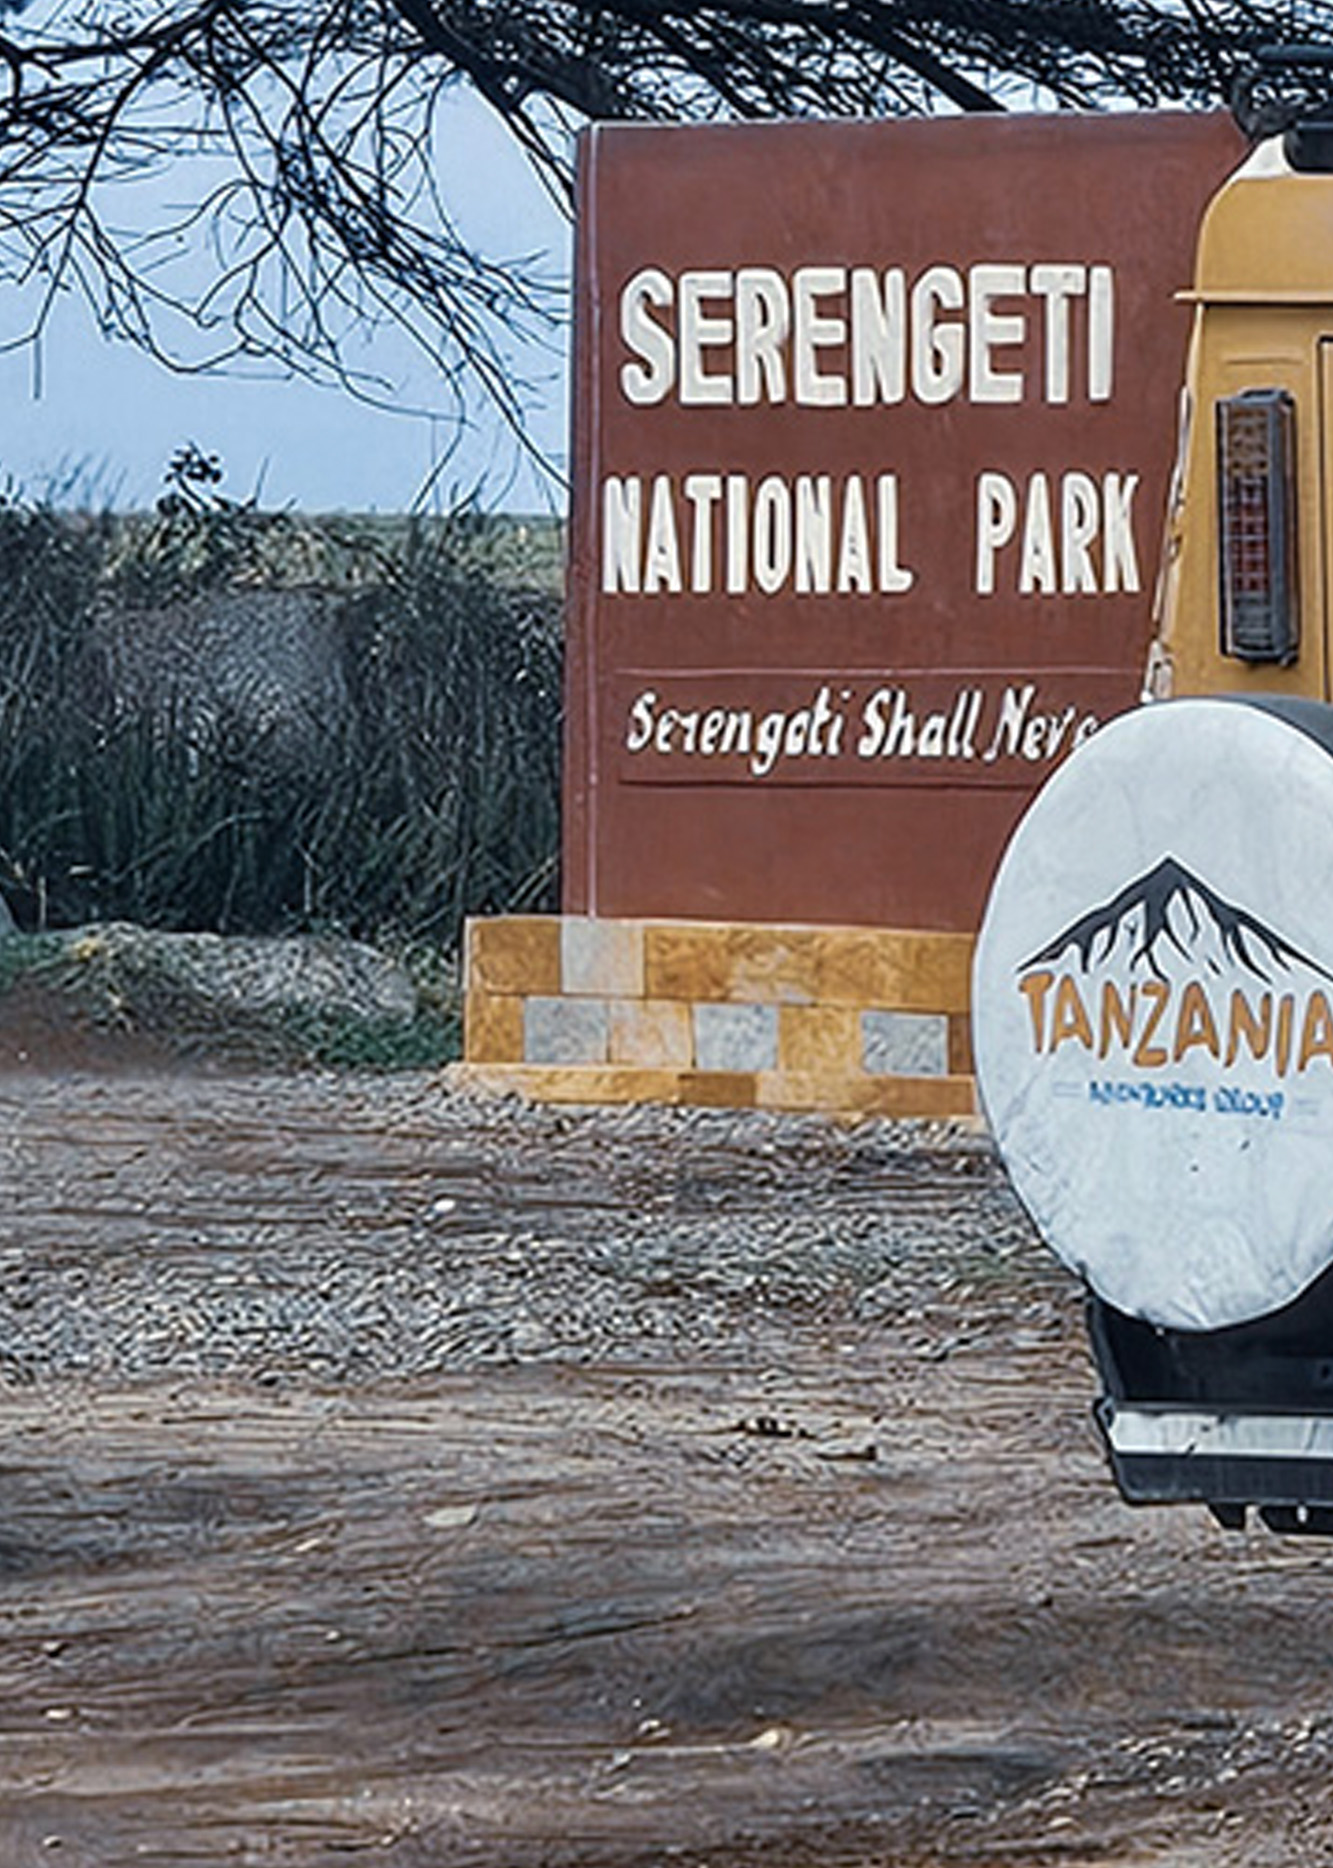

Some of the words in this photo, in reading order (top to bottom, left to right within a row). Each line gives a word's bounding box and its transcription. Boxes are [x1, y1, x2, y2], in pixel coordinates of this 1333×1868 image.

[619, 264, 1114, 406] SERENGETI
[602, 475, 914, 594] NATIONAL
[975, 472, 1142, 594] PARK
[857, 686, 983, 760] Shall
